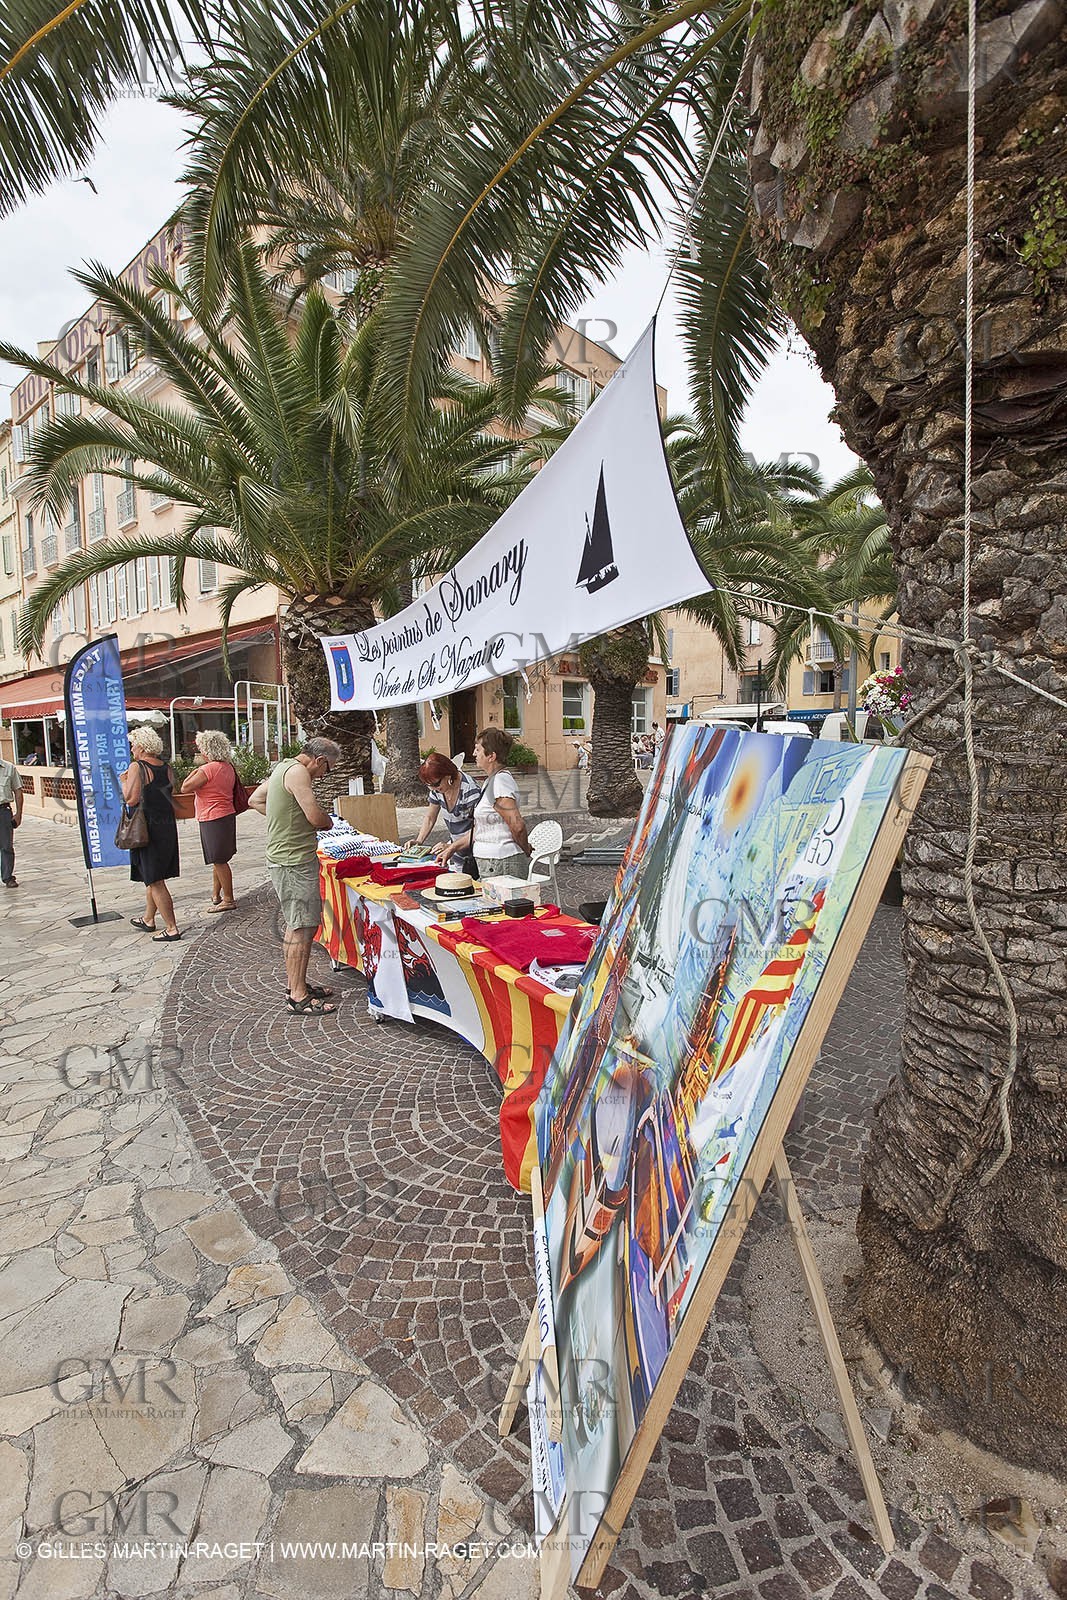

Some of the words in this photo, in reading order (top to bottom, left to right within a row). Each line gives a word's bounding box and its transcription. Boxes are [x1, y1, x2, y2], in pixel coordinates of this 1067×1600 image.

[353, 632, 382, 662] Les
[381, 619, 424, 670] pointus
[423, 603, 443, 638] de
[438, 538, 529, 633] Sanary
[72, 647, 102, 726] IMMEDIAT
[373, 666, 401, 700] Virée
[401, 669, 416, 693] de
[416, 653, 437, 696] St
[438, 636, 506, 691] Nazaire
[105, 677, 125, 735] SANARY
[96, 733, 108, 758] PAR
[115, 738, 127, 757] DE
[76, 730, 102, 863] EMBARQUEMENT
[100, 760, 114, 801] OFFERT
